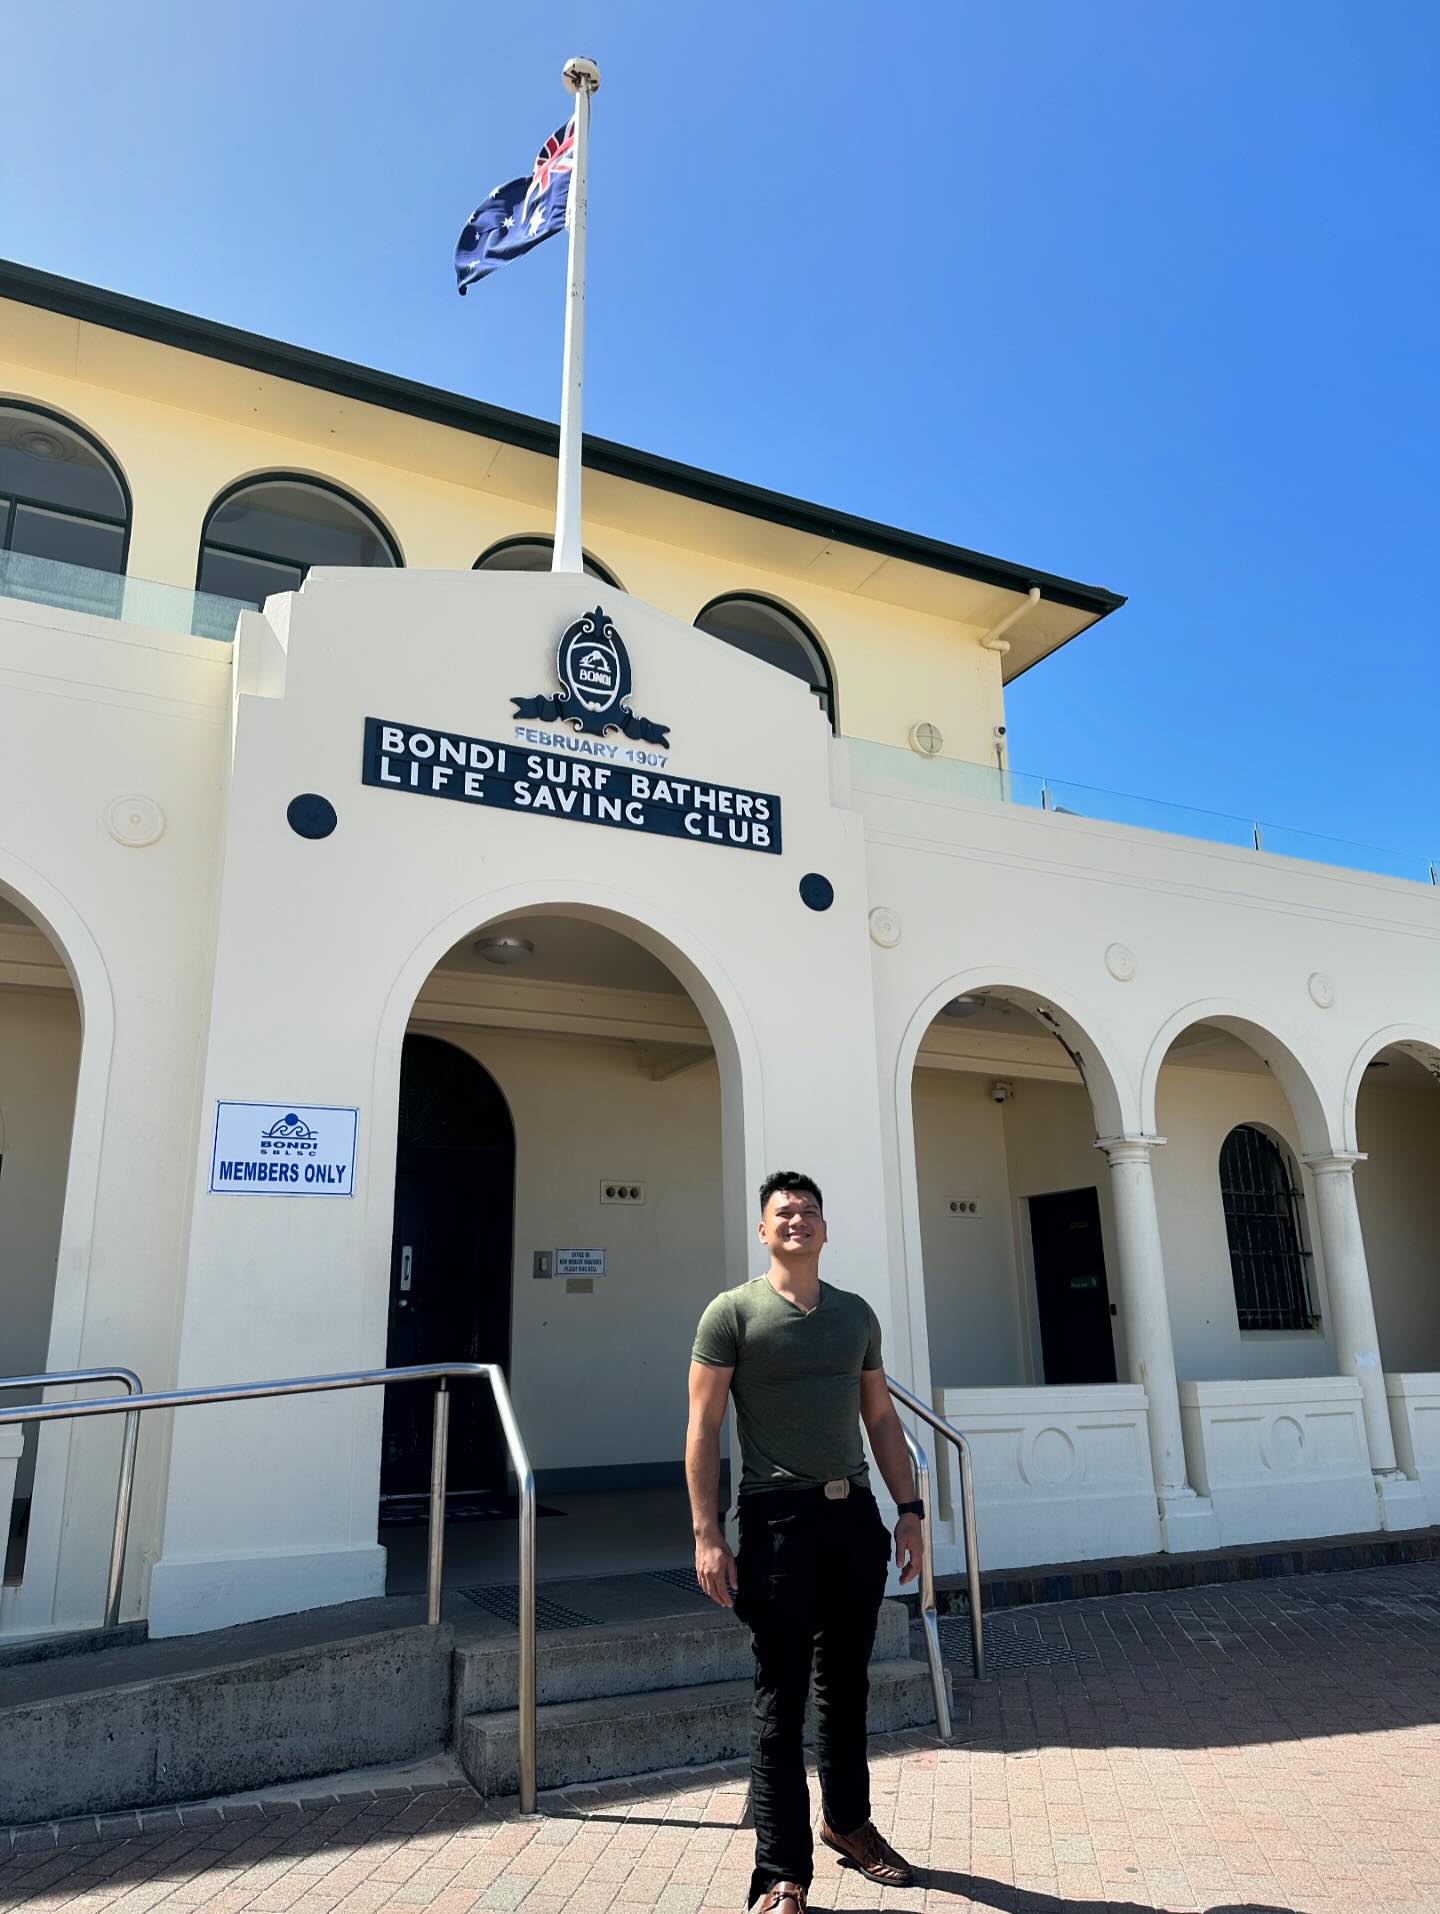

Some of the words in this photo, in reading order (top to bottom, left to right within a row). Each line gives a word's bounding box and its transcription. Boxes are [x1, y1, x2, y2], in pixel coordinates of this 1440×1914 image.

[579, 668, 612, 687] BONDI
[514, 726, 619, 759] FEBRUARY
[625, 749, 669, 769] 1907
[381, 726, 506, 773] BONDI
[527, 755, 611, 791] SURF
[631, 774, 770, 820] BATHERS
[380, 756, 485, 798] LIFE
[514, 780, 644, 825] SAVING
[684, 812, 771, 847] CLUB
[260, 1140, 318, 1150] BONDI
[219, 1160, 300, 1183] MEMBERS
[304, 1163, 347, 1184] ONLY
